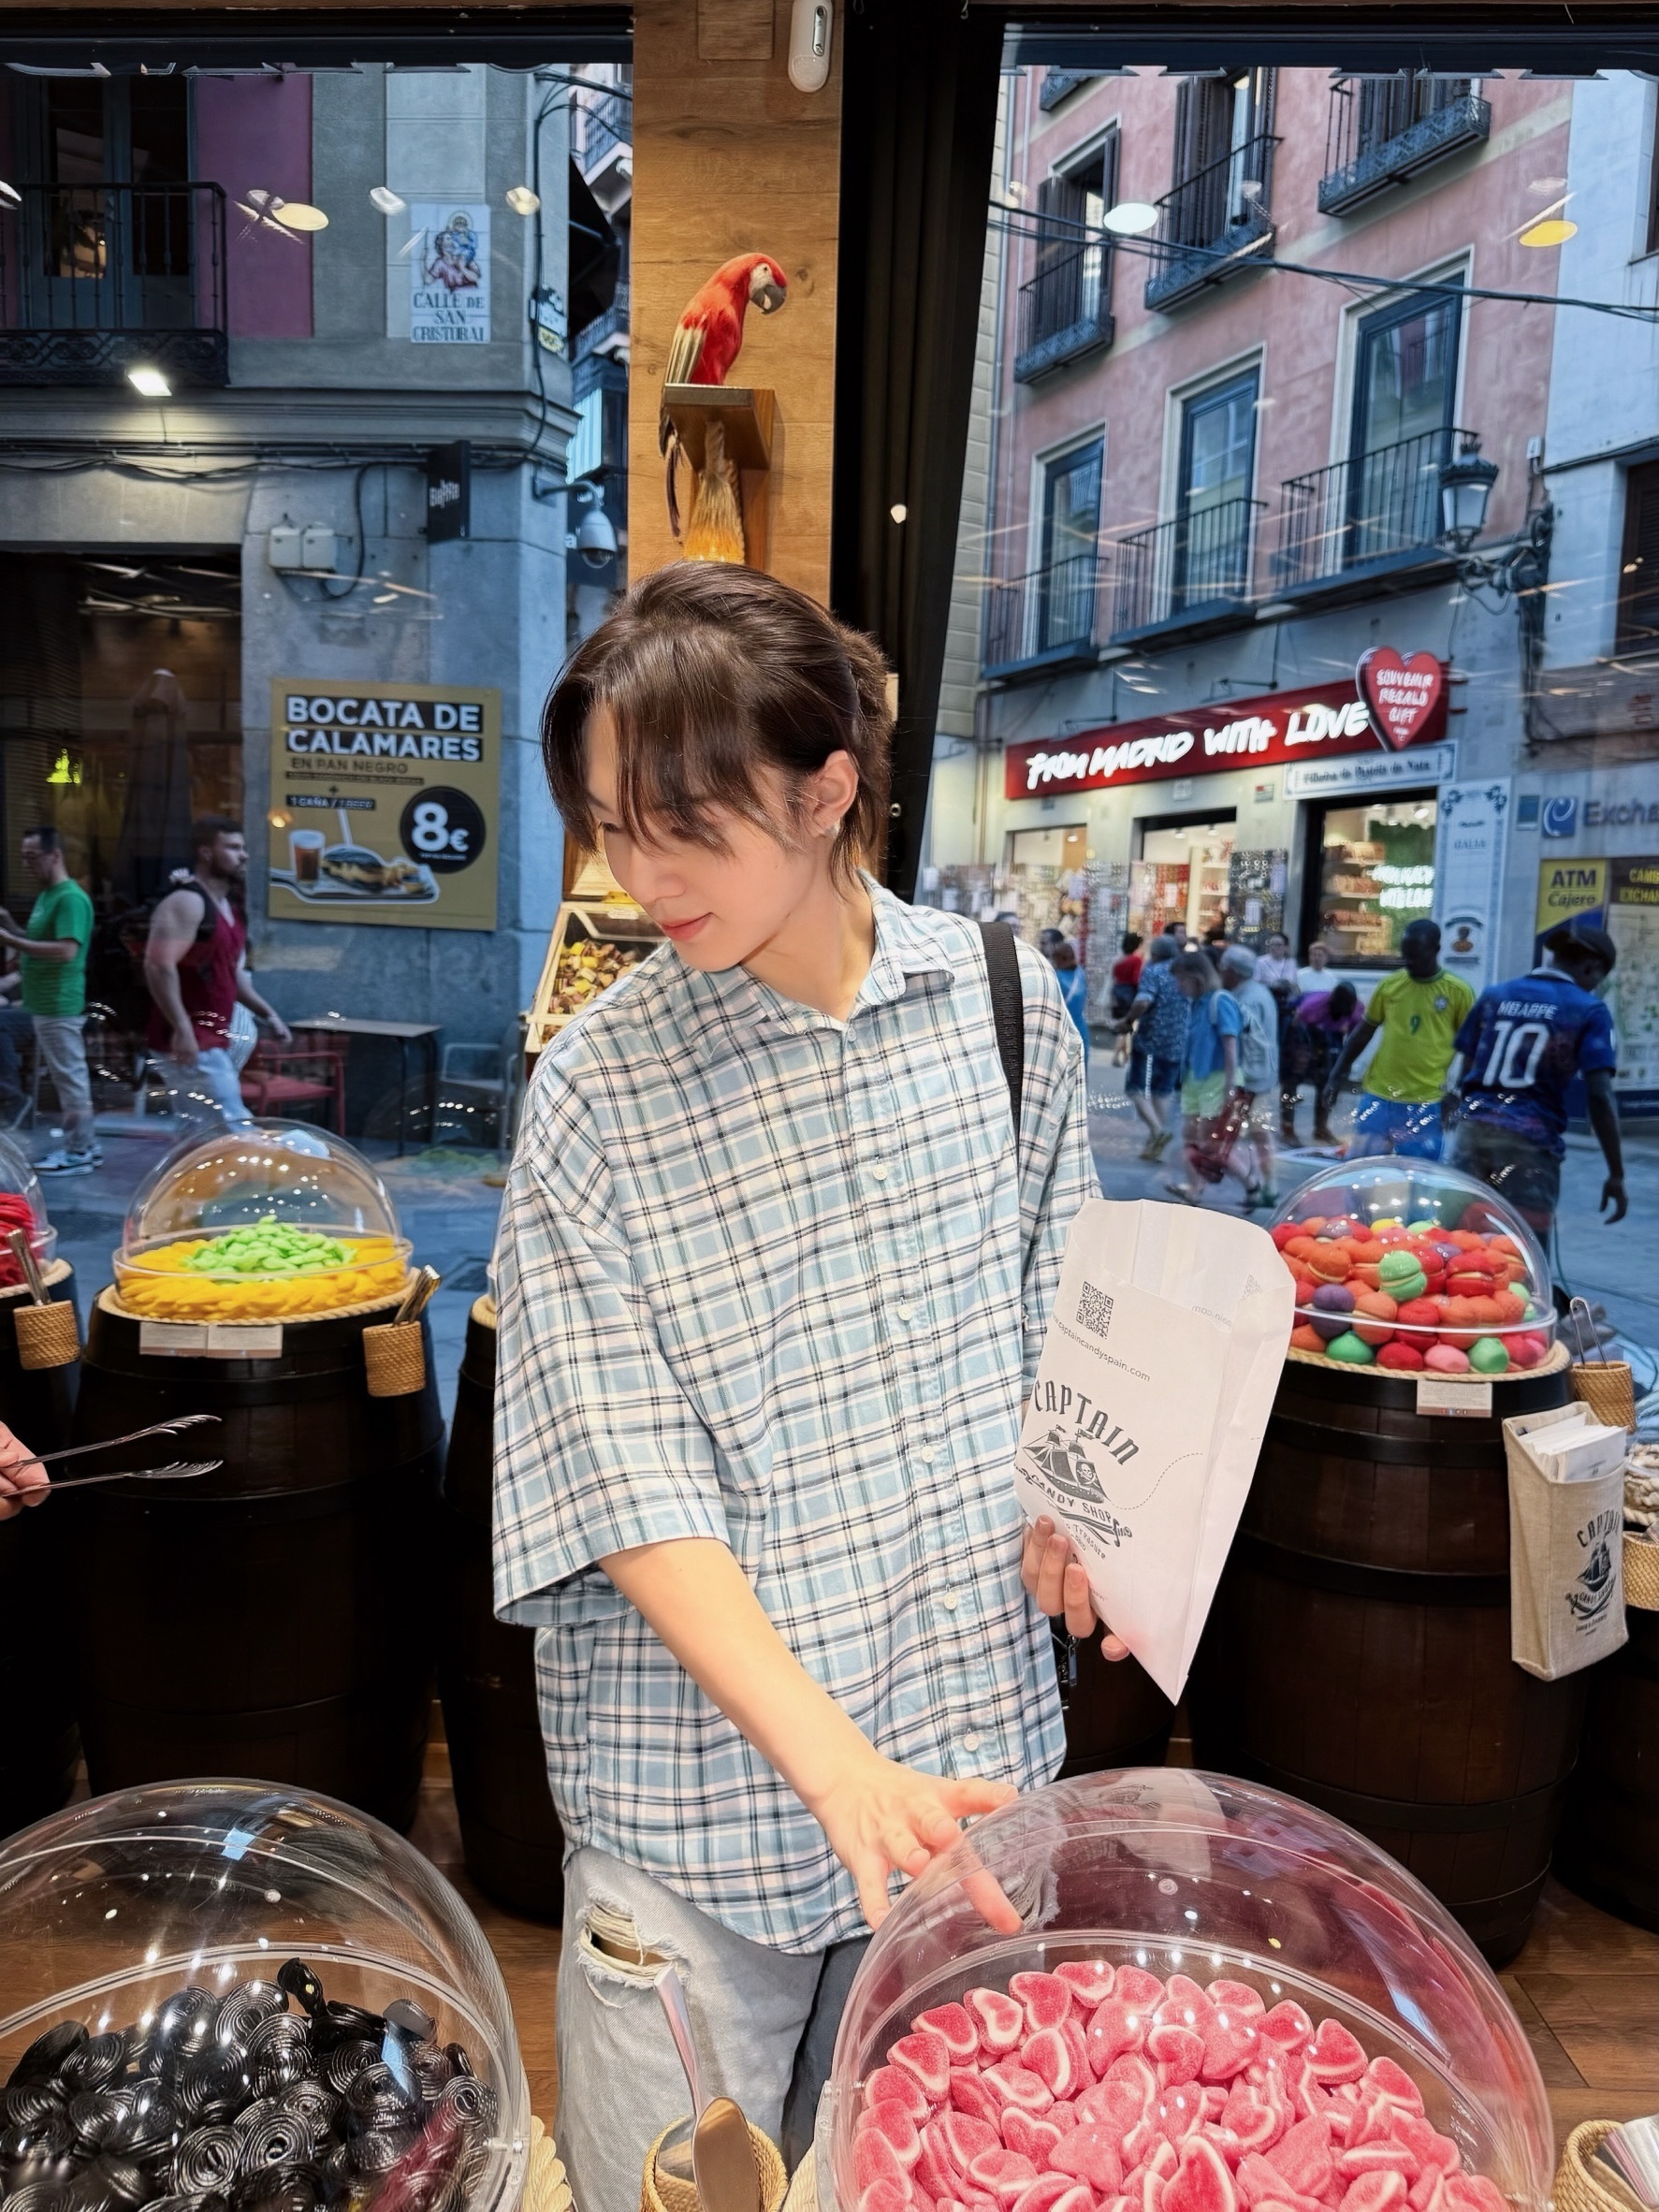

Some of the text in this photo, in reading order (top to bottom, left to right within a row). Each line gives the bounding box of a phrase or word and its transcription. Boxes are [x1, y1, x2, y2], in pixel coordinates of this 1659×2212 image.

[414, 292, 485, 308] CALLE DE
[434, 310, 466, 325] SAN
[1376, 669, 1434, 689] SOUVENIR
[1379, 688, 1428, 706] REGALO
[287, 696, 480, 731] BOCATA DE
[1389, 707, 1418, 724] GIFT
[287, 729, 480, 762] CALAMARES
[1026, 702, 1370, 790] FROM MADRID WITH LOVE
[291, 757, 408, 774] EN PAN NEGRO
[410, 801, 470, 852] 8€
[1550, 869, 1596, 888] ATM
[1548, 891, 1596, 909] Cajero
[1410, 1015, 1421, 1036] 9
[1482, 1020, 1550, 1088] 10
[1034, 1378, 1140, 1465] CAPTAIN
[1082, 1502, 1112, 1524] SHOP
